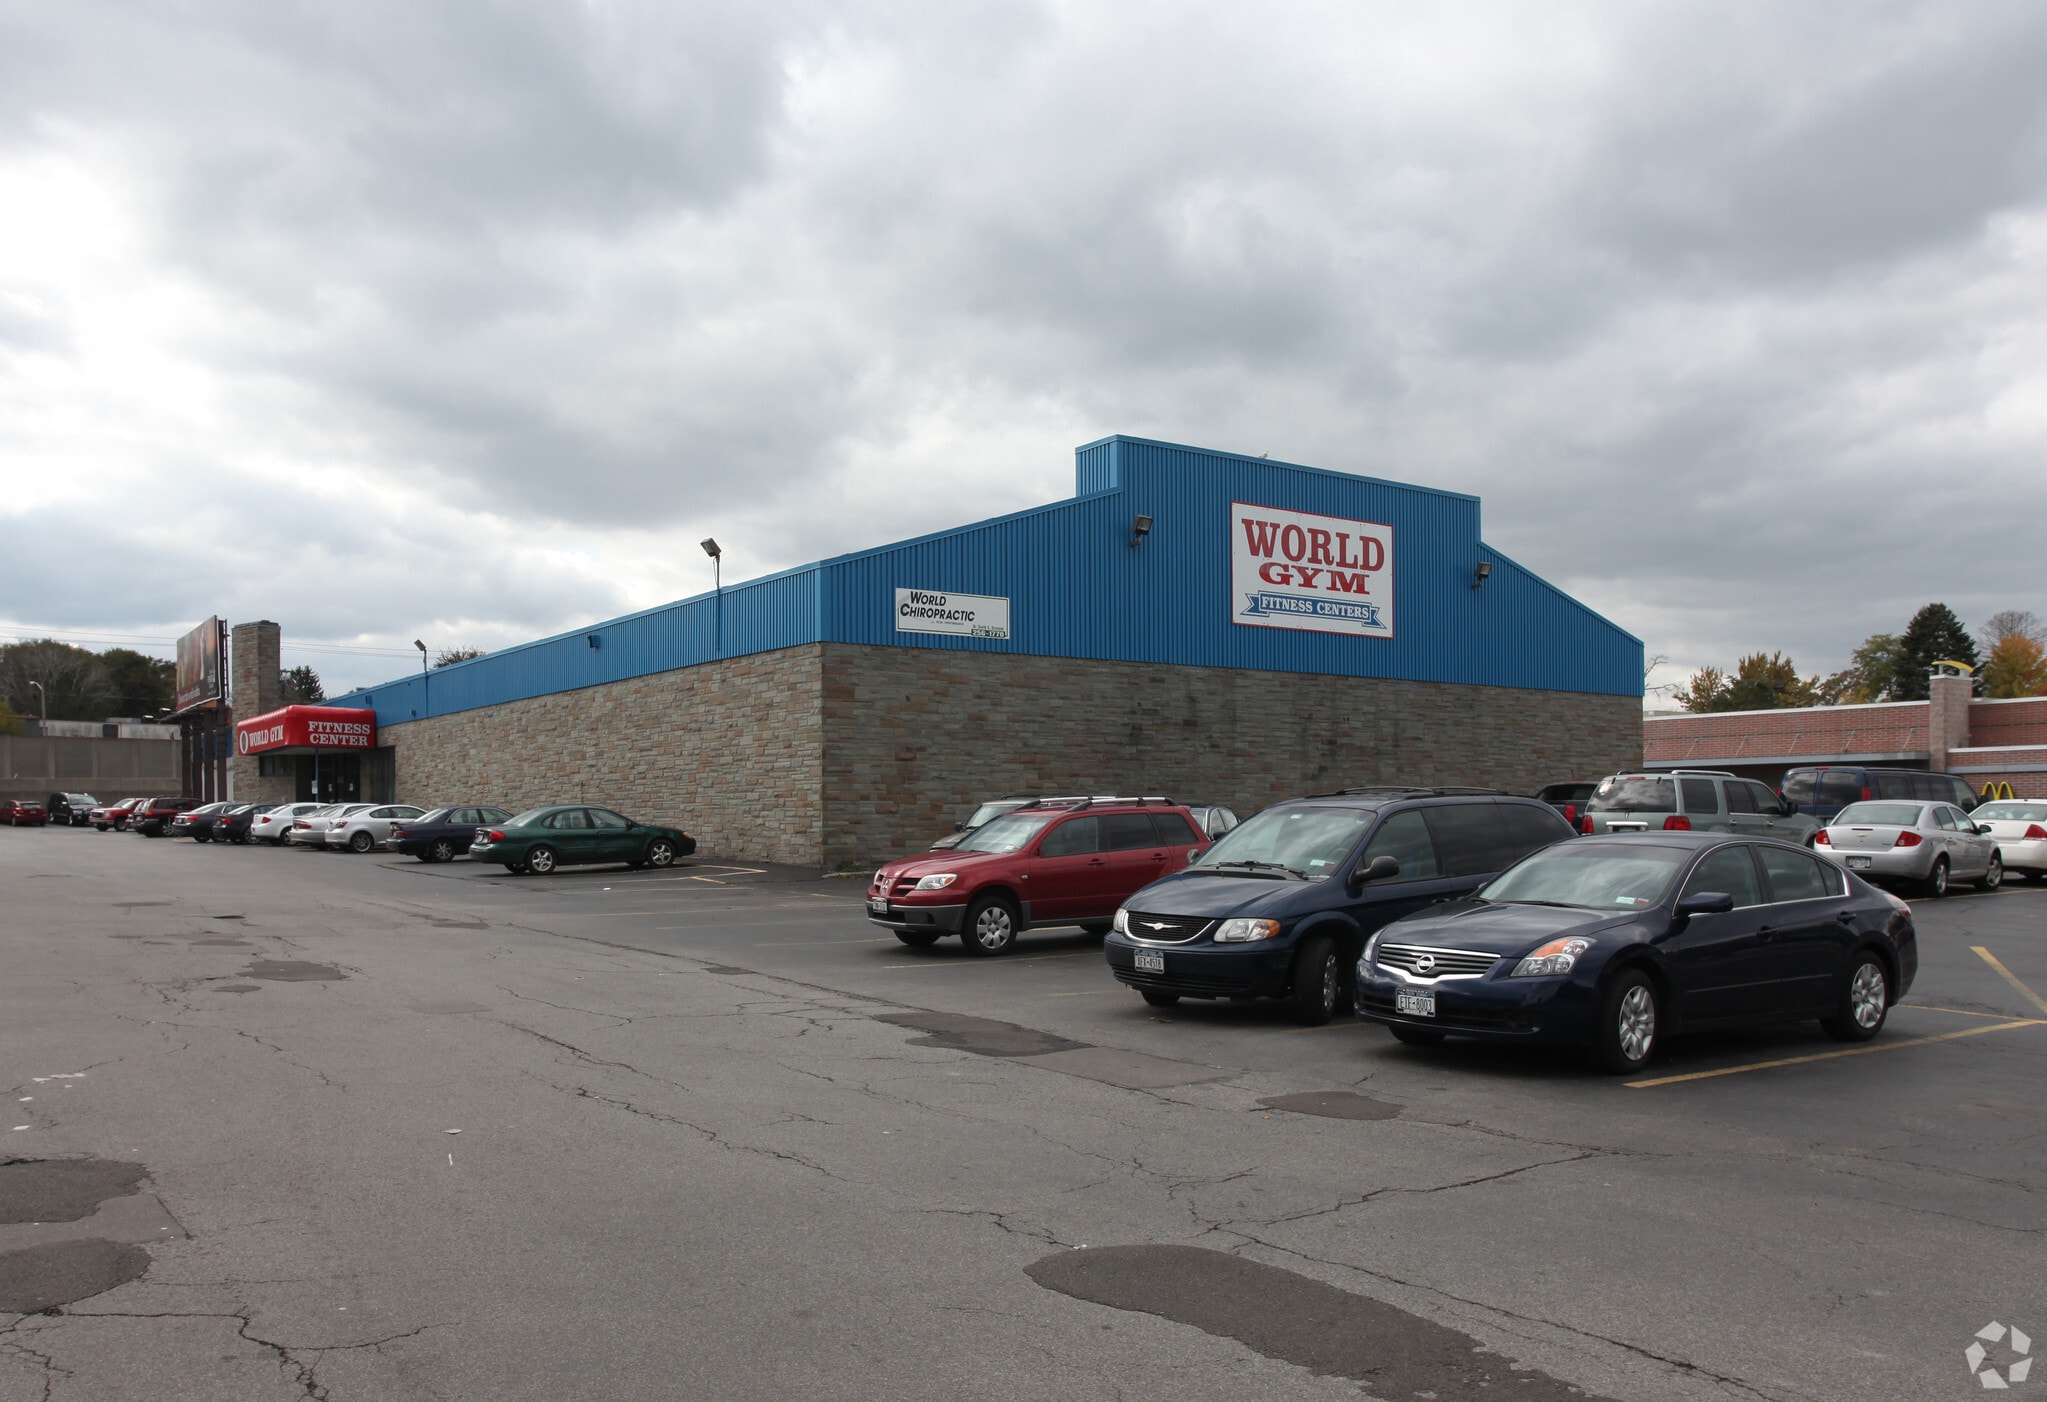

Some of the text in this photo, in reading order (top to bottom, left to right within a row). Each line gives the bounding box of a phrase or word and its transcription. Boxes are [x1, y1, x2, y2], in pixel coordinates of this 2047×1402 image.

[1241, 518, 1385, 572] WORLD
[1258, 562, 1370, 595] GYM
[910, 591, 947, 606] WORLD
[1262, 597, 1369, 619] FITNESS CENTERS
[900, 603, 975, 622] CHIROPRACTIC
[249, 725, 284, 747] WORLD GYM
[308, 721, 371, 734] FITNESS
[309, 733, 368, 746] CENTER
